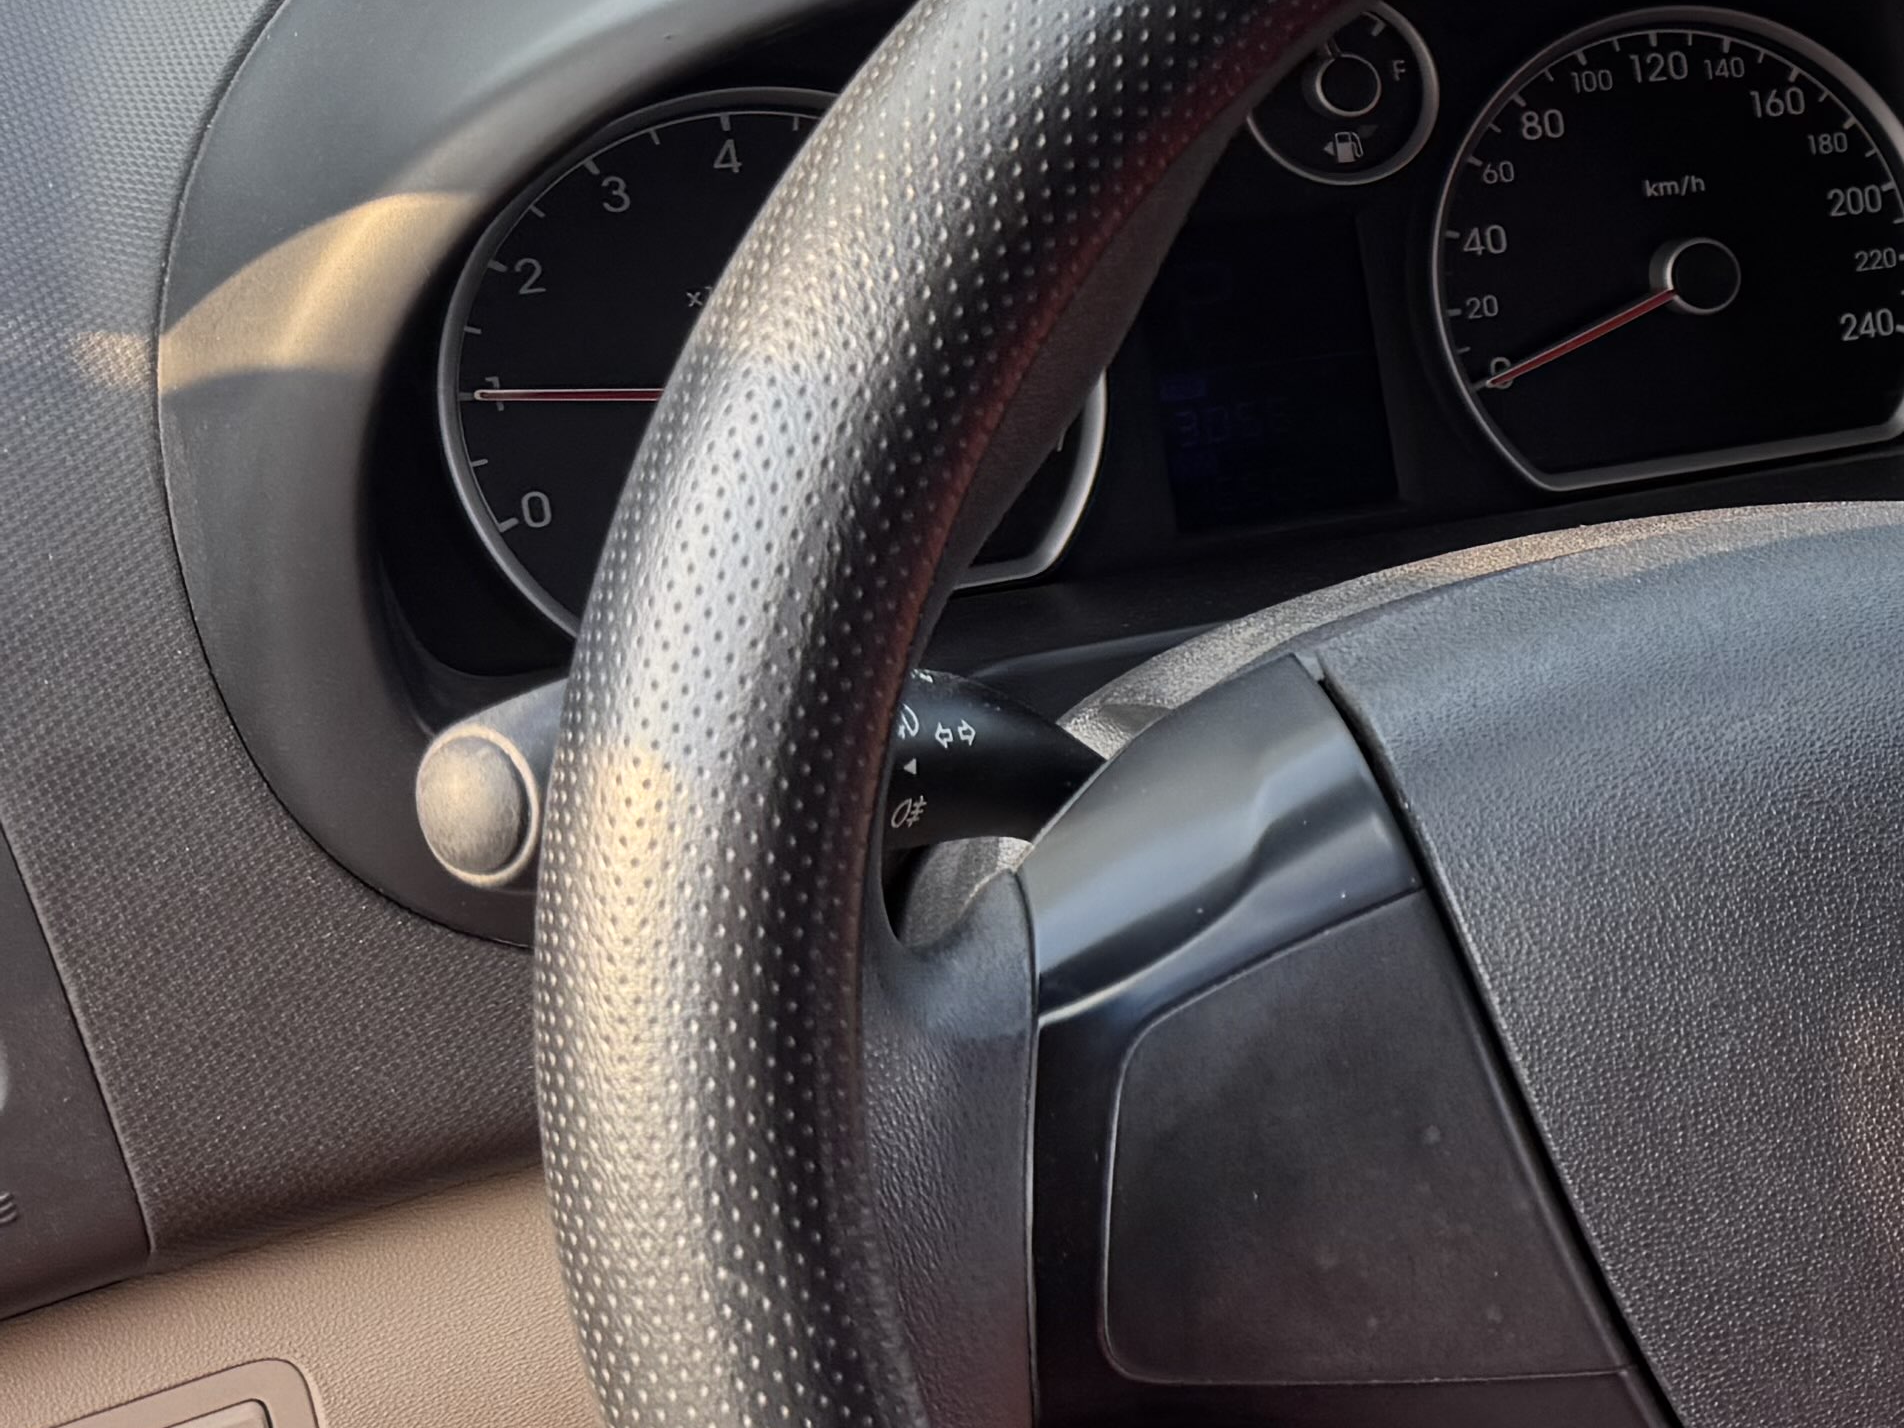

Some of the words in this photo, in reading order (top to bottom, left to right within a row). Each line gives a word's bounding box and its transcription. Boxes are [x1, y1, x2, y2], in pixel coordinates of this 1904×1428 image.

[1391, 58, 1407, 82] F
[1571, 69, 1614, 93] 100
[1629, 52, 1689, 84] 120
[1704, 56, 1746, 80] 140
[1750, 86, 1806, 118] 160
[1520, 109, 1566, 141] 80
[714, 139, 743, 174] 4
[1808, 132, 1848, 155] 180
[1482, 160, 1515, 185] 60
[1642, 175, 1706, 199] km/h
[601, 175, 632, 213] 3
[1827, 186, 1883, 217] 200
[1463, 225, 1508, 256] 40
[515, 257, 546, 295] 2
[1855, 249, 1897, 272] 220
[1466, 295, 1499, 319] 20
[1840, 309, 1894, 342] 240
[485, 376, 504, 411] 1
[521, 491, 552, 528] 0
